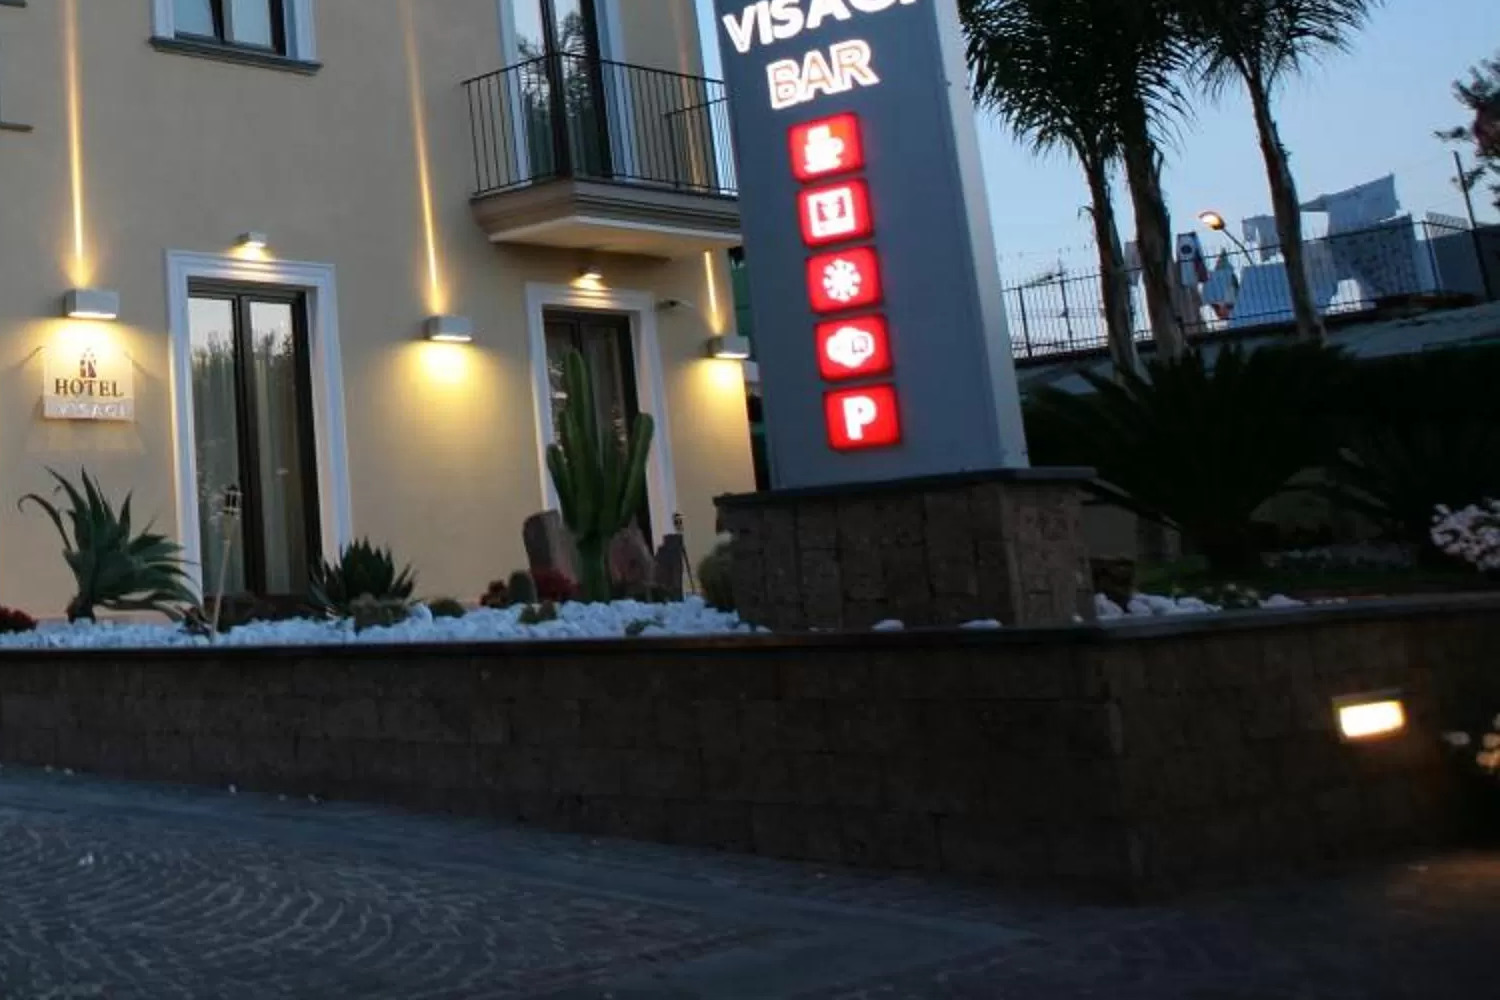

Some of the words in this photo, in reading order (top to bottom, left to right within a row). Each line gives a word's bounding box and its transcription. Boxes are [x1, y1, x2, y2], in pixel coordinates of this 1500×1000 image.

[766, 39, 880, 110] BAR
[53, 377, 125, 397] HOTEL
[843, 395, 878, 440] P
